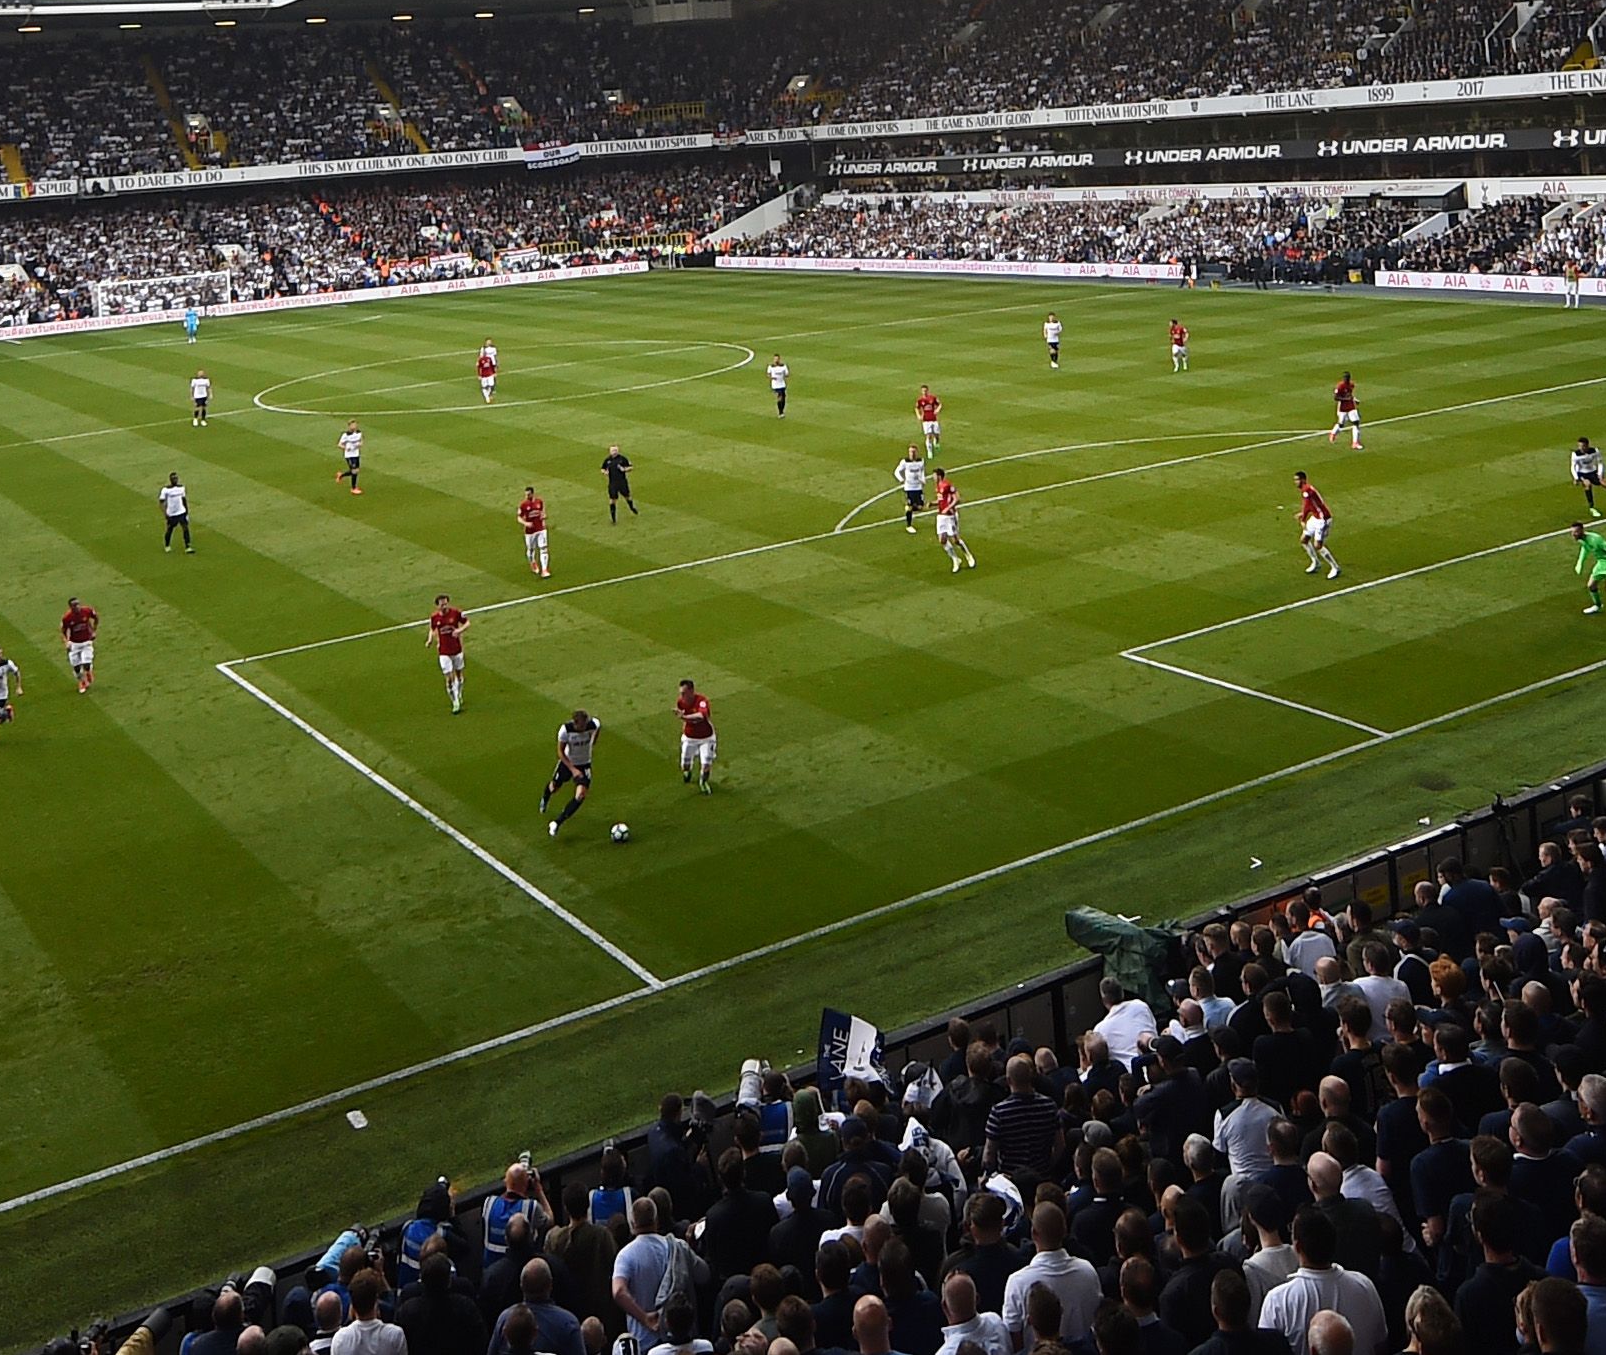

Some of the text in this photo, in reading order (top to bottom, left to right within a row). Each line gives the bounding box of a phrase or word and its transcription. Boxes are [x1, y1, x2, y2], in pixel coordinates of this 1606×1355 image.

[1457, 80, 1485, 97] 2017
[1549, 73, 1574, 91] THE
[1264, 92, 1316, 109] THE LANE
[1367, 86, 1395, 102] 1899
[1064, 103, 1169, 123] TOTTENHAM HOTSPUR
[925, 113, 1032, 131] THE GAME IS ABOUT GLORY
[827, 122, 900, 137] COME ON YOU SPURS
[585, 139, 647, 155] TOTTENHAM
[650, 136, 698, 150] HOTSPUR
[1342, 136, 1408, 155] UNDER
[298, 150, 508, 175] THIS IS MY MY ONE AND ONLY CLUB
[980, 155, 1026, 170] UNDER
[1146, 147, 1204, 164] UNDER
[843, 162, 880, 175] UNDER
[118, 170, 223, 190] TO DARE IS TO DO
[36, 182, 73, 196] SPUR
[1231, 187, 1250, 197] AIA
[1542, 181, 1567, 194] AIA
[1081, 190, 1097, 200] AIA
[537, 271, 556, 281] AIA
[581, 266, 599, 276] AIA
[1079, 264, 1097, 275] AIA
[1122, 265, 1140, 276] AIA
[1167, 266, 1184, 277] AIA
[447, 279, 467, 291] AIA
[493, 275, 511, 286] AIA
[1387, 273, 1410, 286] AIA
[1443, 275, 1468, 288] AIA
[1503, 277, 1529, 291] AIA
[401, 284, 420, 296] AIA
[829, 1027, 849, 1081] LANE
